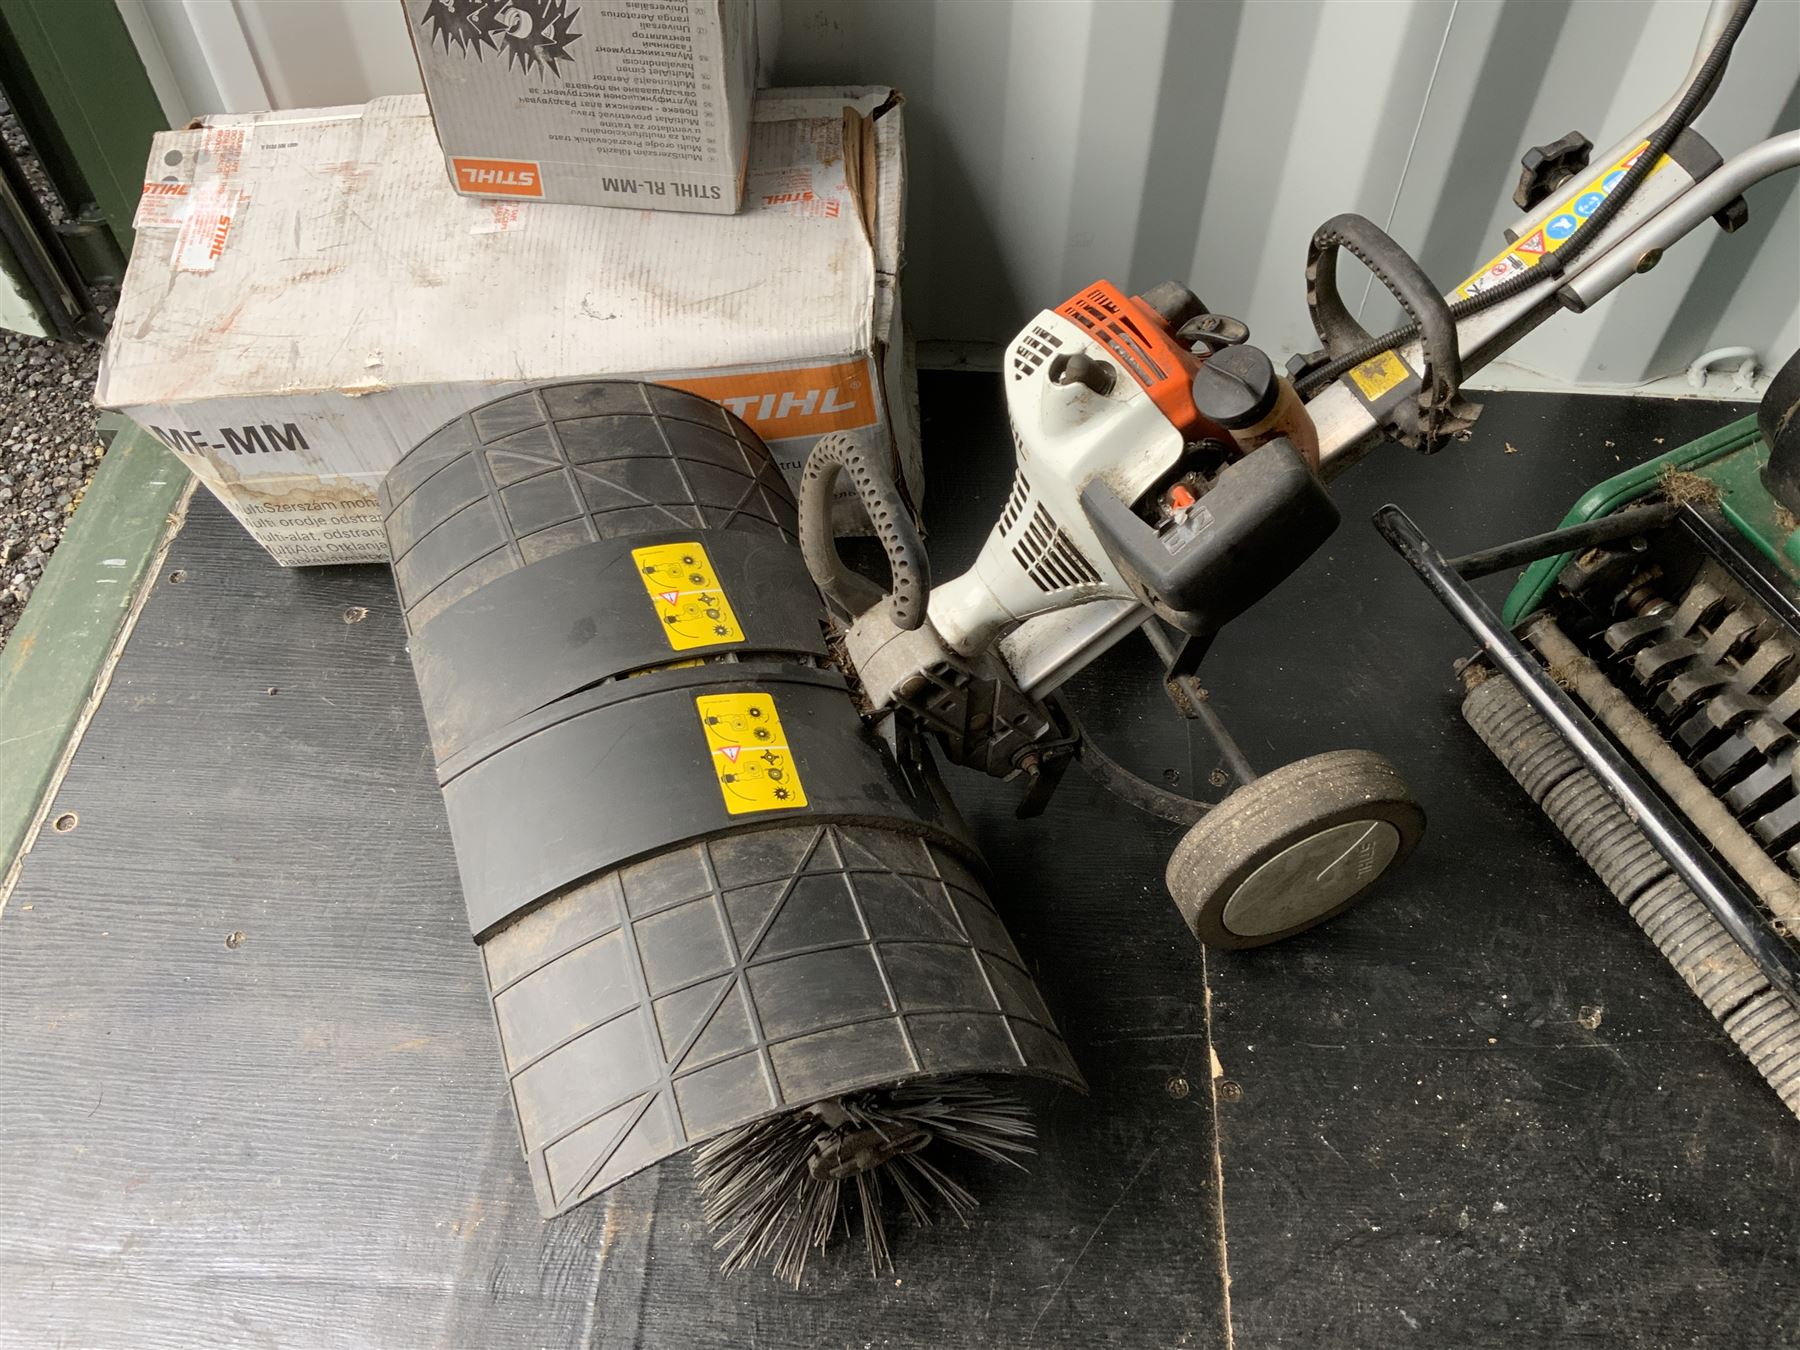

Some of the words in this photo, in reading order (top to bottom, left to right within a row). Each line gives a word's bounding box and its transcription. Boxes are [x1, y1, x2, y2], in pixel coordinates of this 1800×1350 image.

[461, 168, 535, 187] STIHL
[601, 177, 666, 196] RL-MM
[143, 183, 190, 195] STIHL
[669, 182, 721, 200] STIHL
[762, 191, 814, 205] STIHL
[209, 215, 230, 259] STIHL
[711, 388, 857, 420] TIHL
[150, 423, 310, 457] MF-MM
[280, 516, 327, 528] orodje
